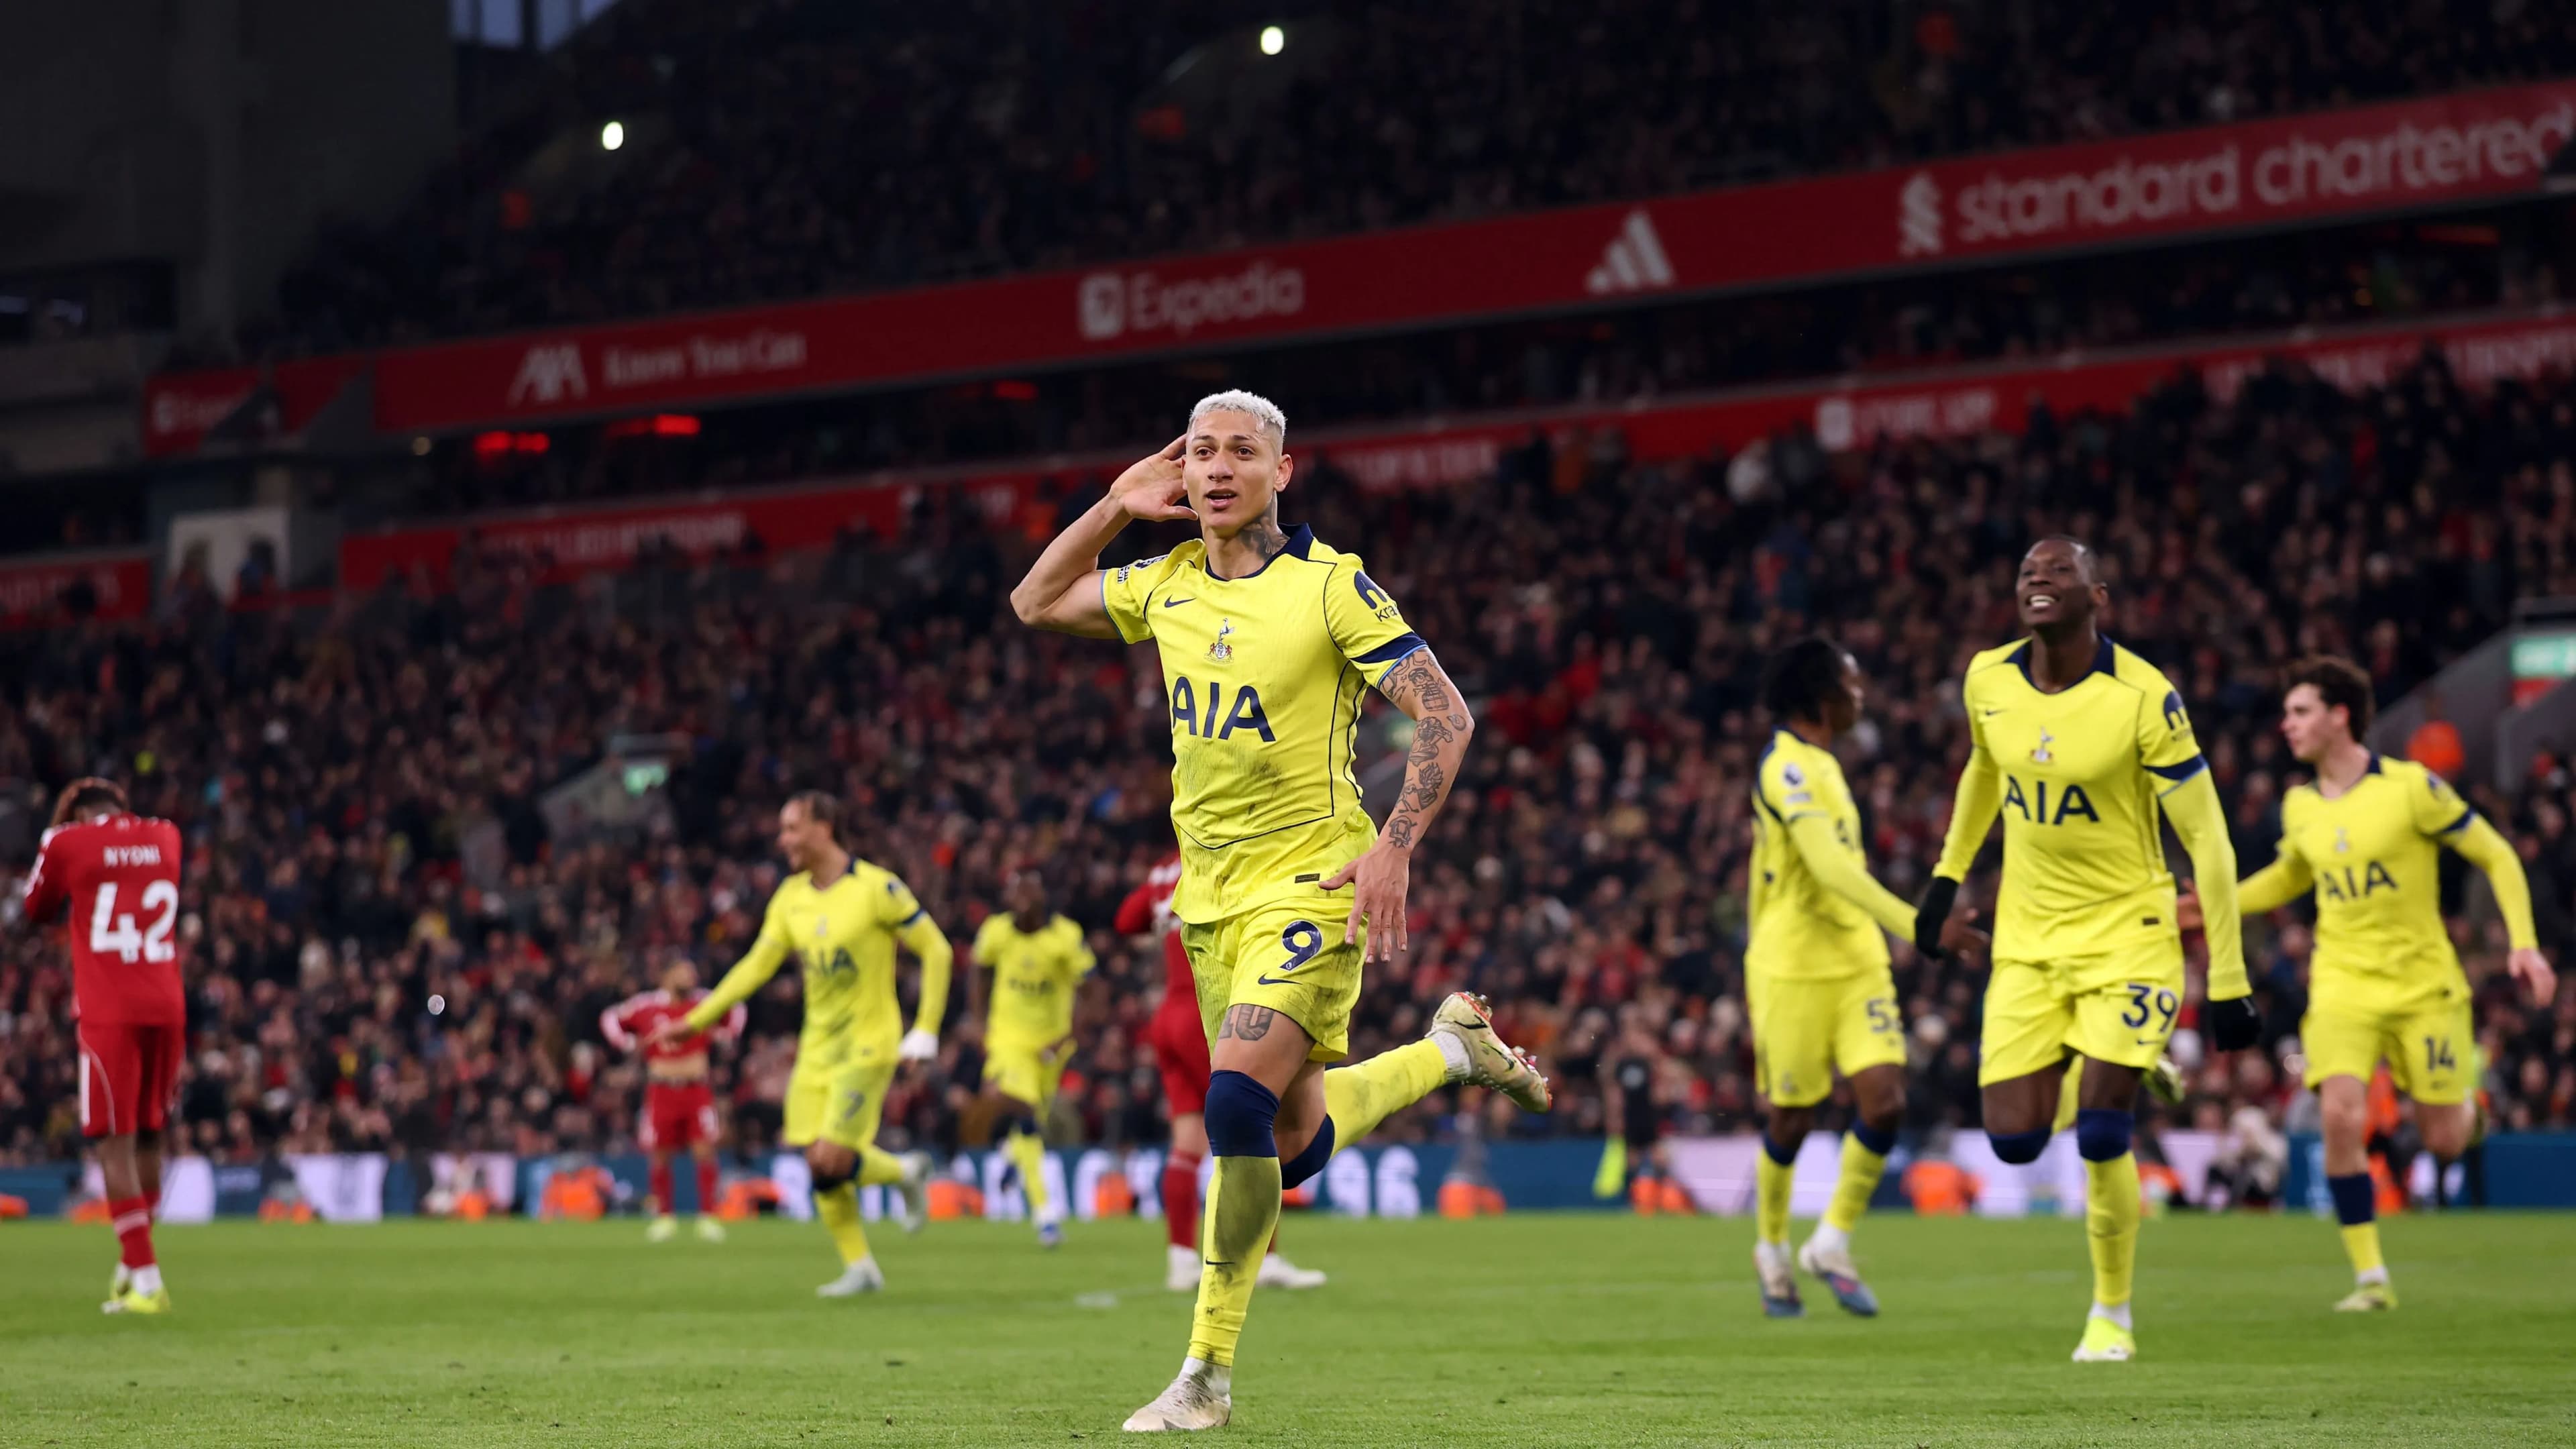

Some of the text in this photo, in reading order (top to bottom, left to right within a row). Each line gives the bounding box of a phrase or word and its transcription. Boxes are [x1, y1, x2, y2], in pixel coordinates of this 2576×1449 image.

[1957, 101, 2574, 242] standard chartered
[1132, 260, 1305, 337] Expedia
[505, 341, 590, 408] AXA
[1374, 602, 1399, 623] kra
[1171, 676, 1276, 743] AIA
[2004, 773, 2100, 826] AIA
[103, 845, 161, 867] NYONI
[2322, 860, 2398, 902] AIA
[89, 878, 179, 965] 42
[1279, 919, 1323, 971] 9
[2121, 983, 2178, 1033] 39
[2424, 1036, 2455, 1071] 14
